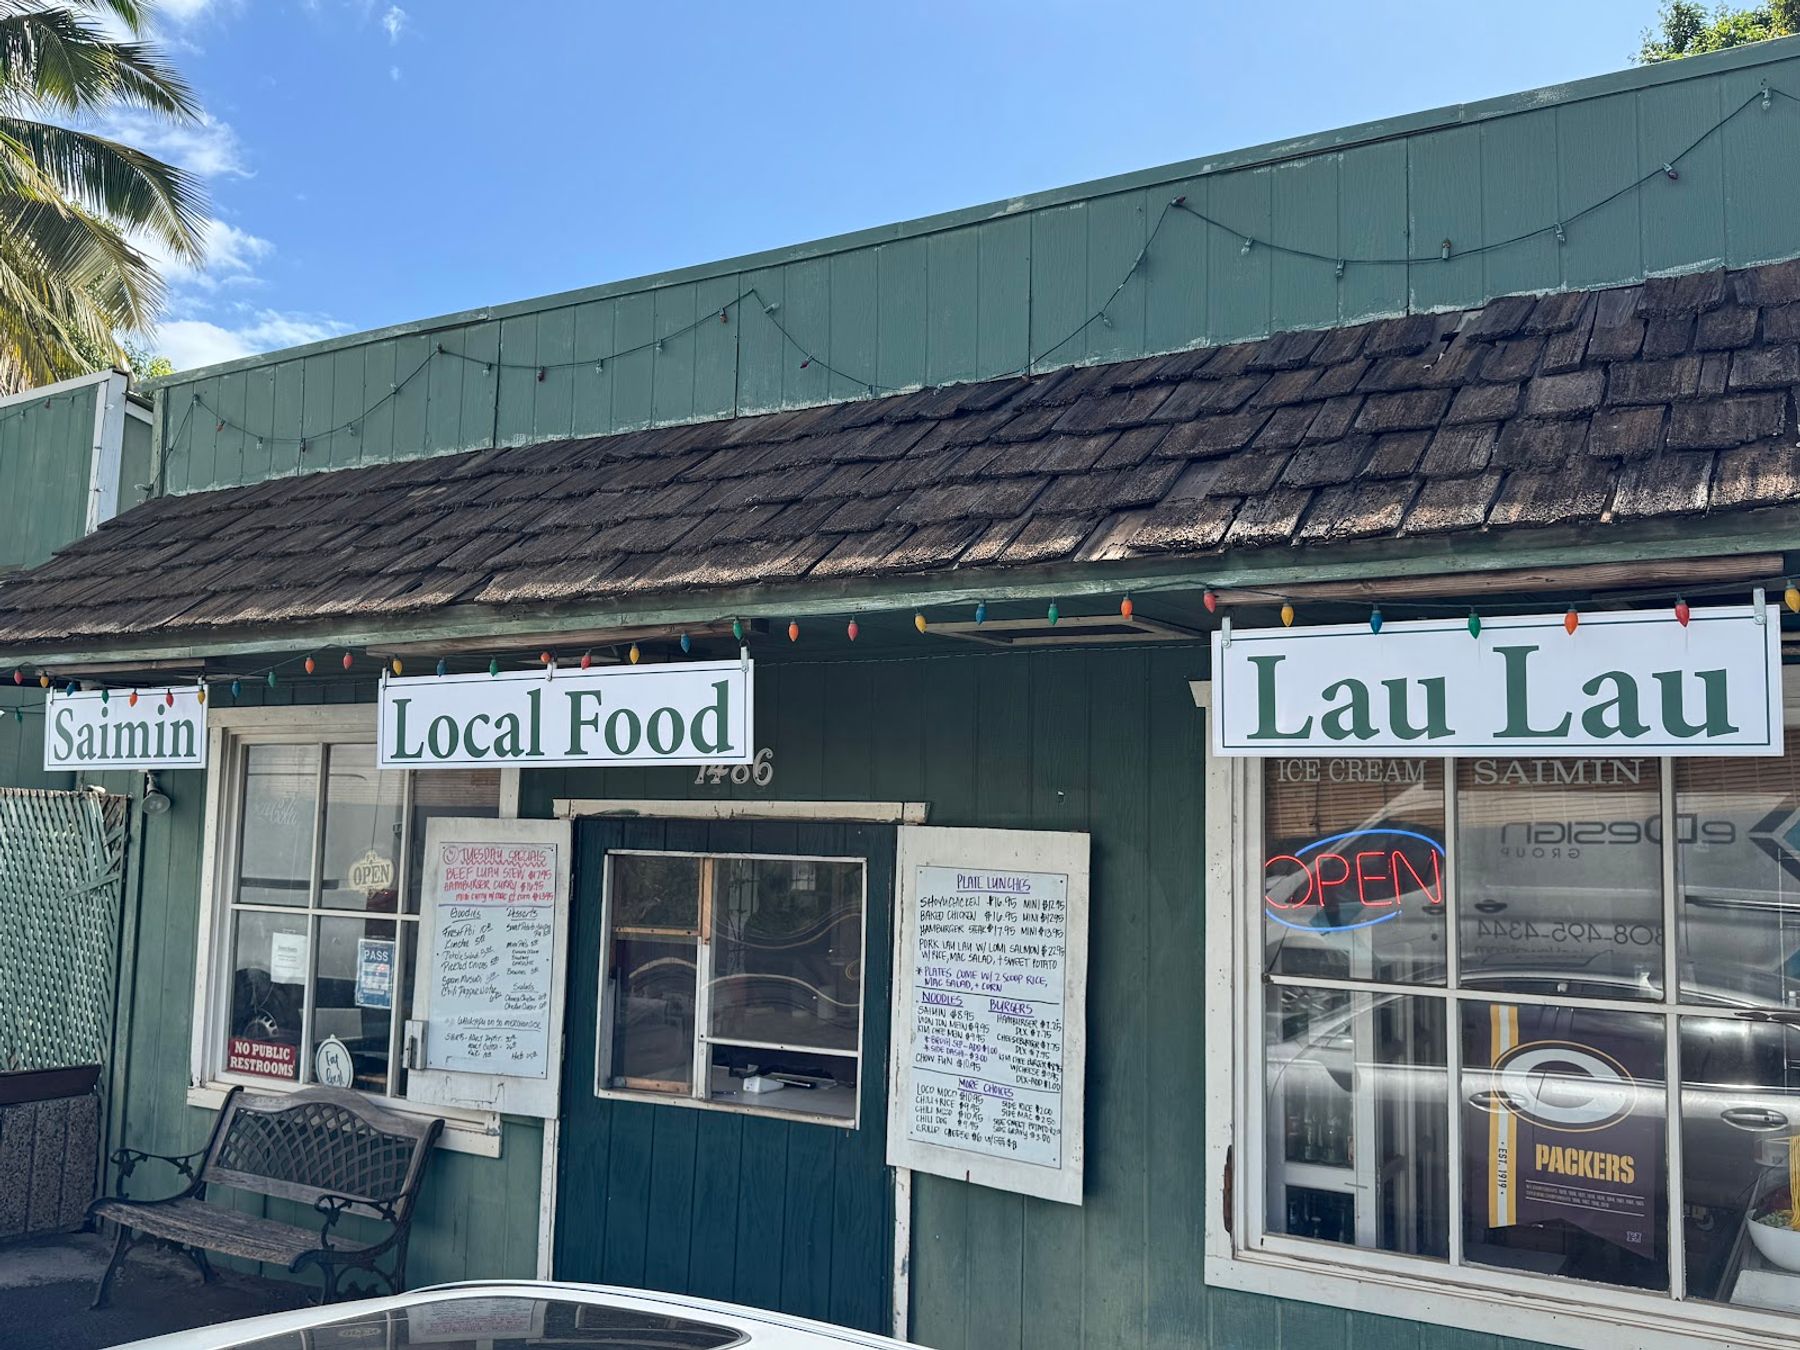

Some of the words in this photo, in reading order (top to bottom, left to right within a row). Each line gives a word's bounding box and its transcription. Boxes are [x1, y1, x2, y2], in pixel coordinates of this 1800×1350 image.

[1247, 655, 1456, 740] Lau
[1492, 645, 1739, 739] Lau
[390, 687, 545, 760] Local
[563, 679, 735, 757] Food
[53, 703, 197, 761] Saimin
[1277, 758, 1321, 783] ICE
[1328, 758, 1427, 783] CREAM
[1473, 758, 1646, 786] SAIMIN
[353, 863, 390, 886] OPEN
[957, 873, 984, 890] PLATE
[987, 876, 1031, 891] LUNCHES
[1265, 849, 1443, 909] OPEN
[1022, 899, 1040, 911] MINI
[1022, 912, 1039, 923] MINI
[1020, 926, 1038, 937] MINI
[364, 949, 389, 961] PASS
[919, 938, 940, 951] PORK
[988, 942, 1007, 954] LOMI
[1009, 943, 1040, 955] SALMON
[924, 965, 952, 978] PLATES
[924, 977, 943, 987] MAC
[922, 990, 963, 1006] NOODLES
[990, 999, 1033, 1016] BURGERS
[917, 1005, 947, 1018] SAIMIN
[234, 1040, 250, 1054] NO
[252, 1043, 291, 1061] PUBLIC
[229, 1055, 294, 1077] RESTROOMS
[958, 1077, 979, 1091] MORE
[983, 1083, 1015, 1099] CHOICES
[1497, 1148, 1508, 1168] EST.
[1535, 1143, 1636, 1185] PACKERS
[1497, 1169, 1508, 1189] 1919
